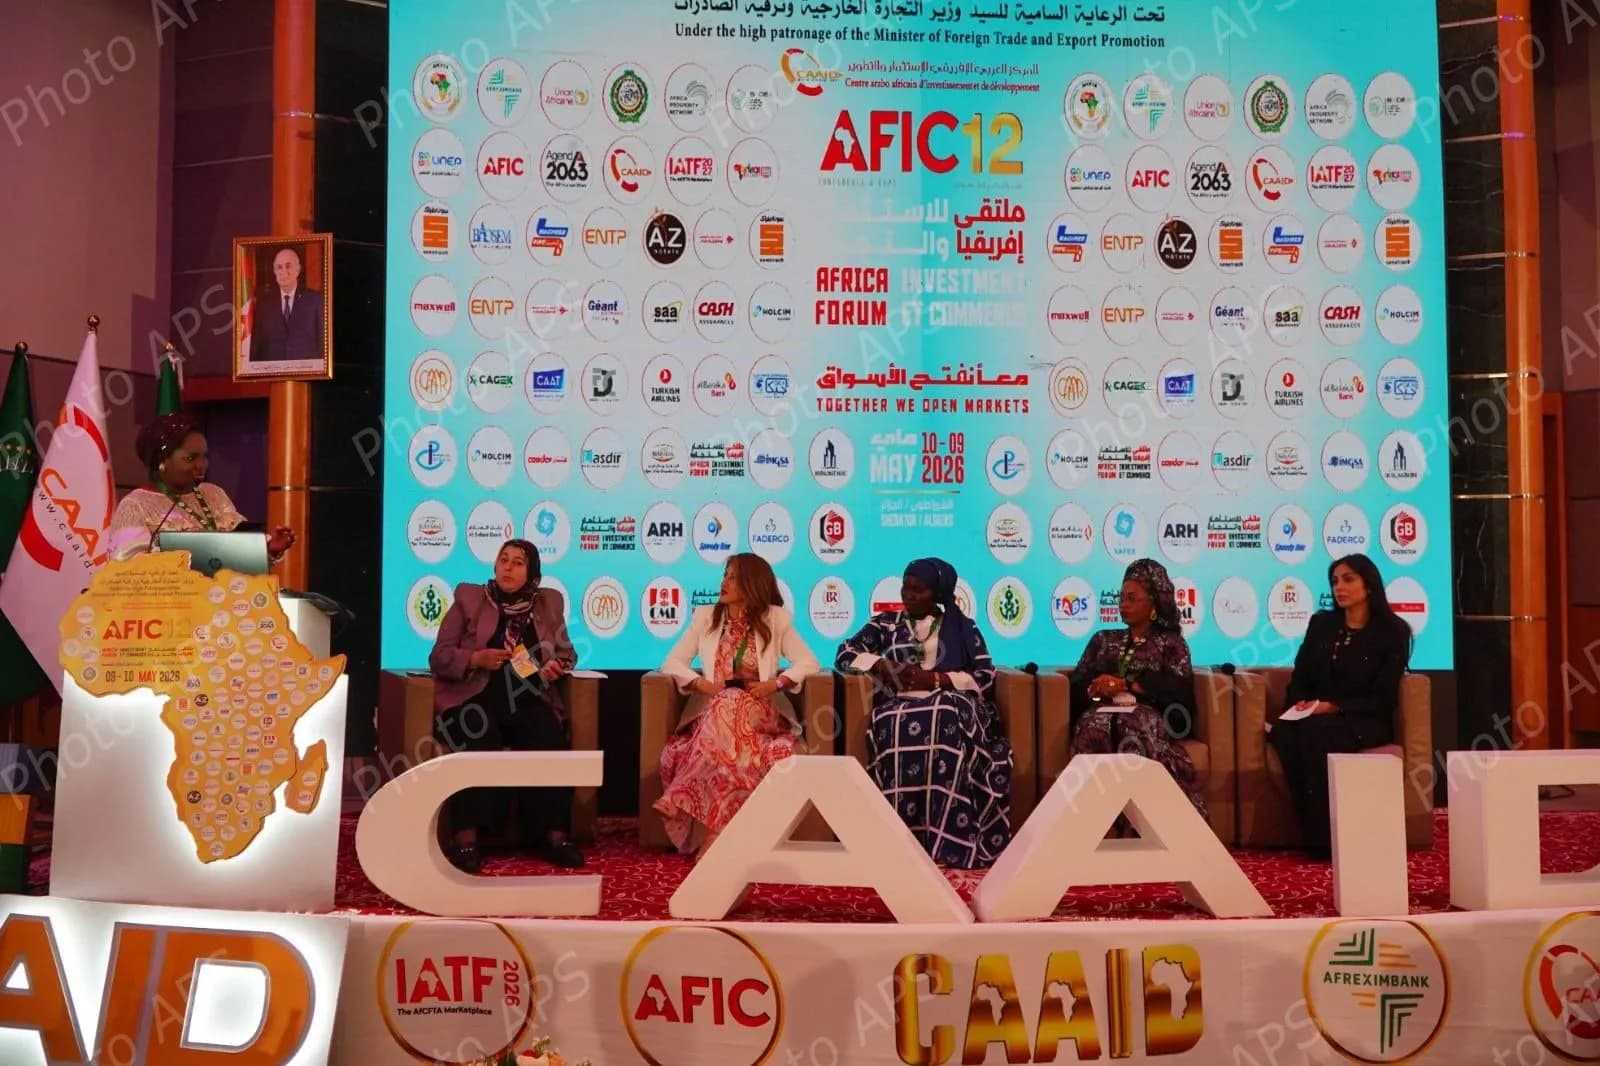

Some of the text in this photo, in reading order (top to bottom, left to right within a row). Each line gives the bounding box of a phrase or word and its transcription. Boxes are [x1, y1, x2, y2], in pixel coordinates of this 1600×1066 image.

[929, 3, 961, 22] وزير
[970, 4, 1009, 24] للسيد
[1015, 4, 1068, 25] السامية
[1075, 6, 1127, 26] الرعاية
[1134, 6, 1165, 22] تحت
[675, 23, 1165, 50] Under the high patronage of the Minister of Foreign Trade and Export Promotion
[845, 78, 869, 88] Centre
[483, 157, 524, 176] AFIC
[546, 161, 588, 181] 2063
[669, 157, 702, 176] IATF
[1310, 165, 1343, 183] IATF
[1131, 170, 1170, 188] AFIC
[1190, 173, 1231, 191] 2063
[954, 198, 1026, 228] ملتقى
[585, 229, 627, 245] ENTP
[1103, 235, 1144, 251] ENTP
[956, 229, 1024, 264] إفريقيا
[816, 267, 889, 293] AFRICA
[414, 302, 456, 312] maxwell
[471, 300, 514, 316] ENTP
[654, 306, 677, 318] saa
[698, 302, 734, 316] CASH
[762, 308, 791, 316] HOLCIM
[815, 300, 887, 326] FORUM
[1104, 307, 1145, 323] ENTP
[1324, 306, 1360, 320] CASH
[1390, 311, 1419, 319] HOLCIM
[1051, 310, 1090, 321] maxwell
[1275, 310, 1299, 322] saa
[479, 375, 513, 385] CAGEX
[536, 375, 561, 386] CAAT
[1168, 380, 1191, 391] CAAT
[650, 395, 681, 403] AIRLINES
[651, 387, 680, 395] TURKISH
[1275, 390, 1303, 398] TURKISH
[816, 397, 1030, 413] TOGETHER WE OPEN MARKETS
[1274, 398, 1304, 406] AIRLINES
[482, 453, 512, 461] HOLCIM
[1060, 455, 1088, 463] HOLCIM
[870, 454, 964, 484] MAY 2026
[647, 522, 683, 537] ARH
[826, 522, 842, 536] GB
[1163, 523, 1199, 539] ARH
[1397, 523, 1413, 536] GB
[752, 534, 789, 543] FADERCO
[1327, 536, 1365, 544] FADERCO
[103, 619, 164, 640] AFIC
[139, 670, 158, 683] MAY
[396, 956, 497, 1004] IATF
[503, 960, 520, 1008] 2026
[1323, 972, 1429, 989] AFREXIMBANK
[635, 973, 772, 1028] AFIC
[893, 943, 1205, 1066] CAAID
[397, 1008, 411, 1016] The
